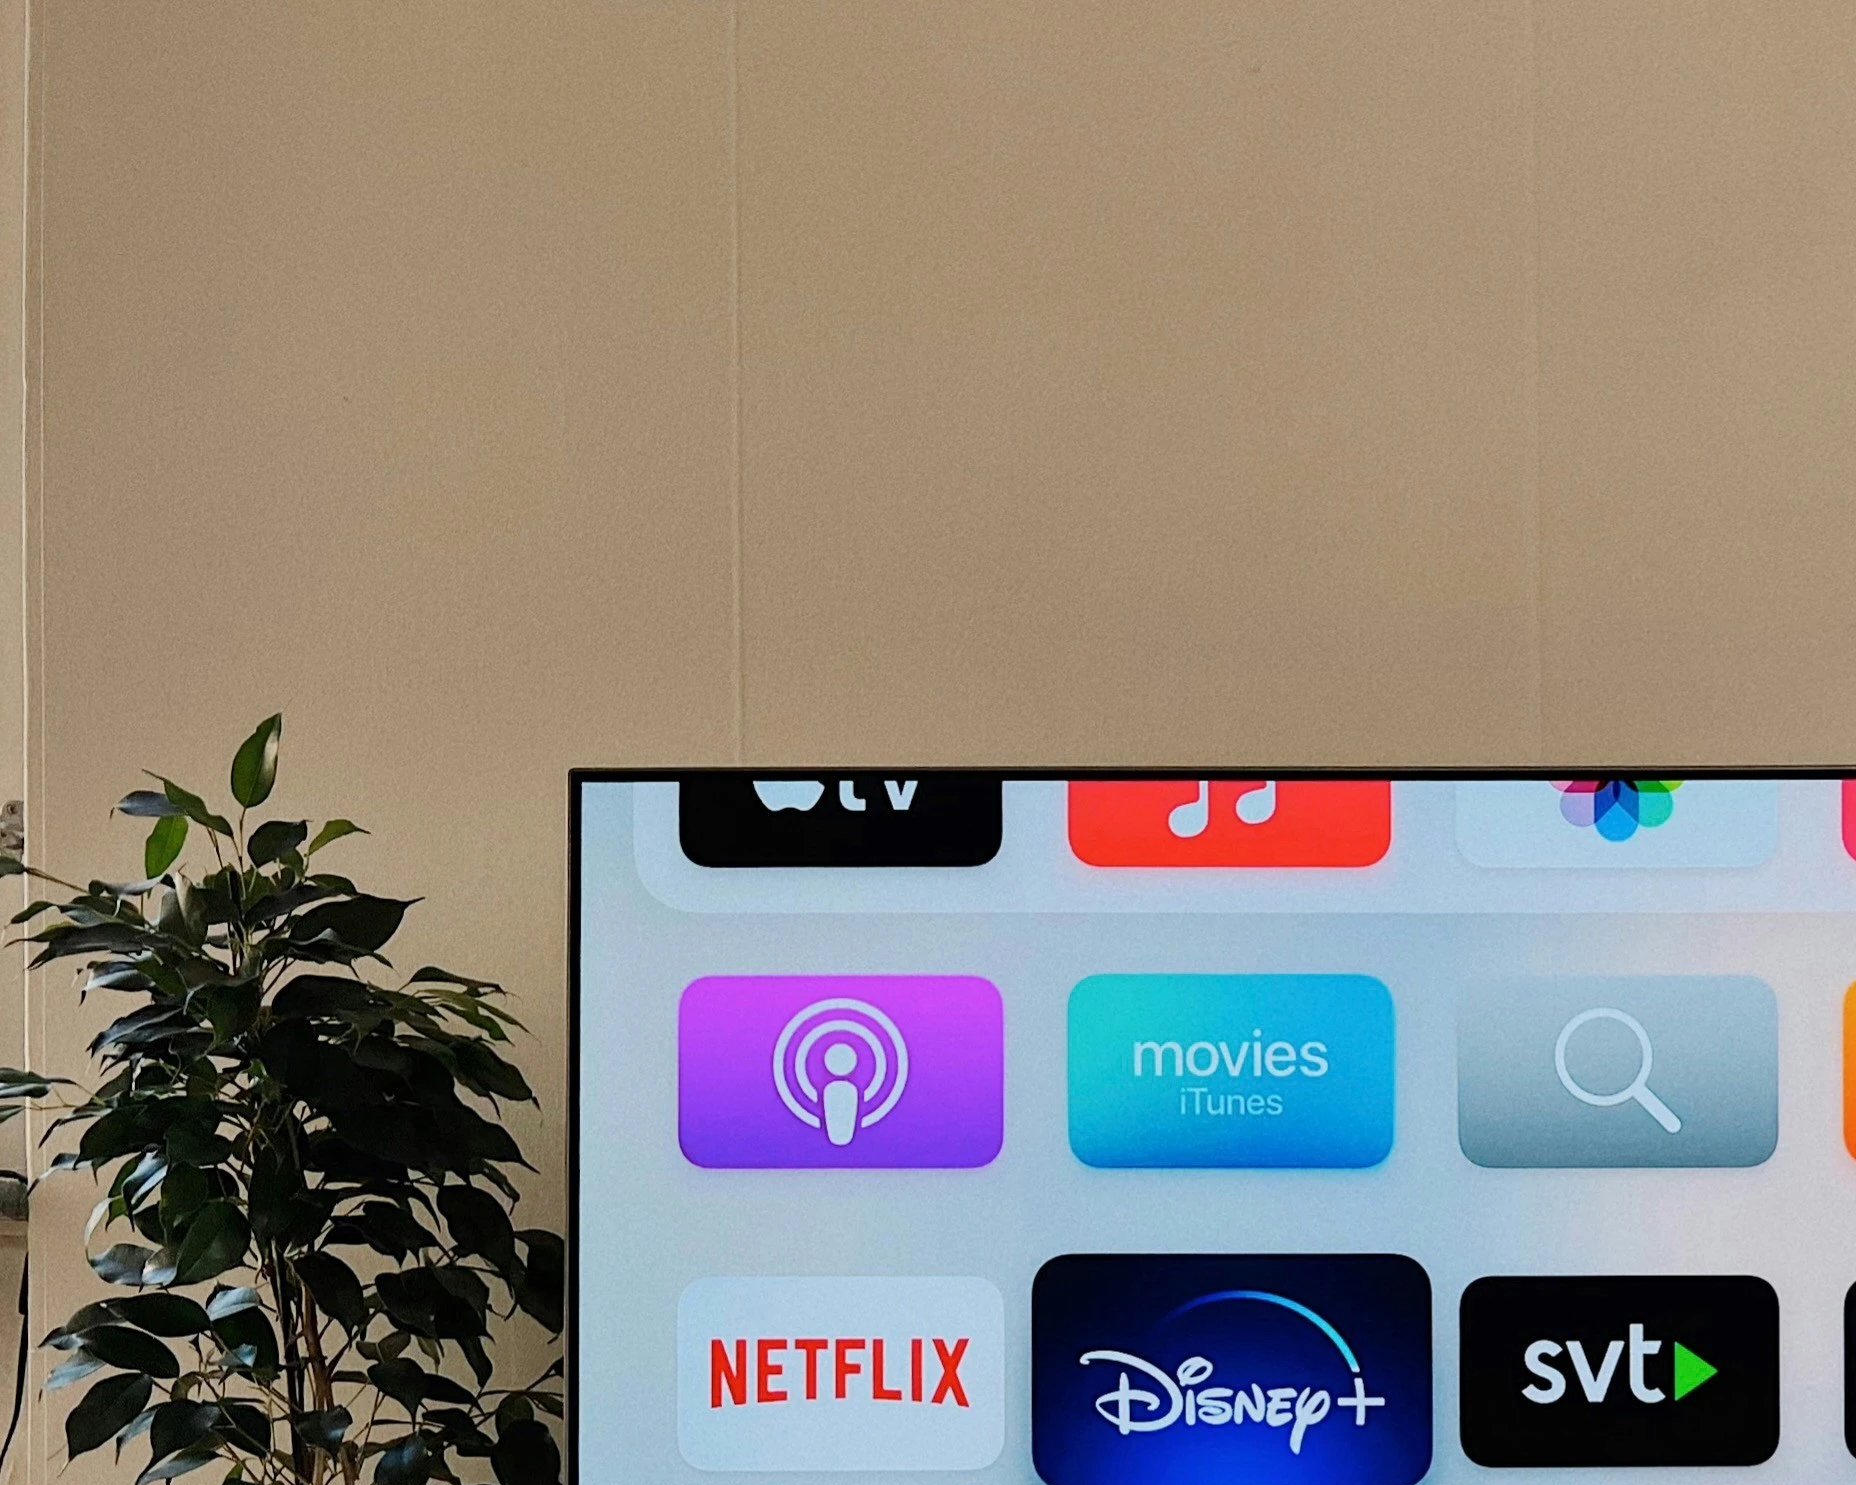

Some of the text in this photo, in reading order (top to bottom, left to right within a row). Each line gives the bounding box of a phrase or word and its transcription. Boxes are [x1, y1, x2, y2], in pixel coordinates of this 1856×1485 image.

[1133, 1028, 1329, 1077] movies
[1179, 1087, 1283, 1115] iTunes
[711, 1338, 970, 1408] NETFLIX
[1522, 1323, 1666, 1404] svt
[1080, 1350, 1386, 1454] Disney+
